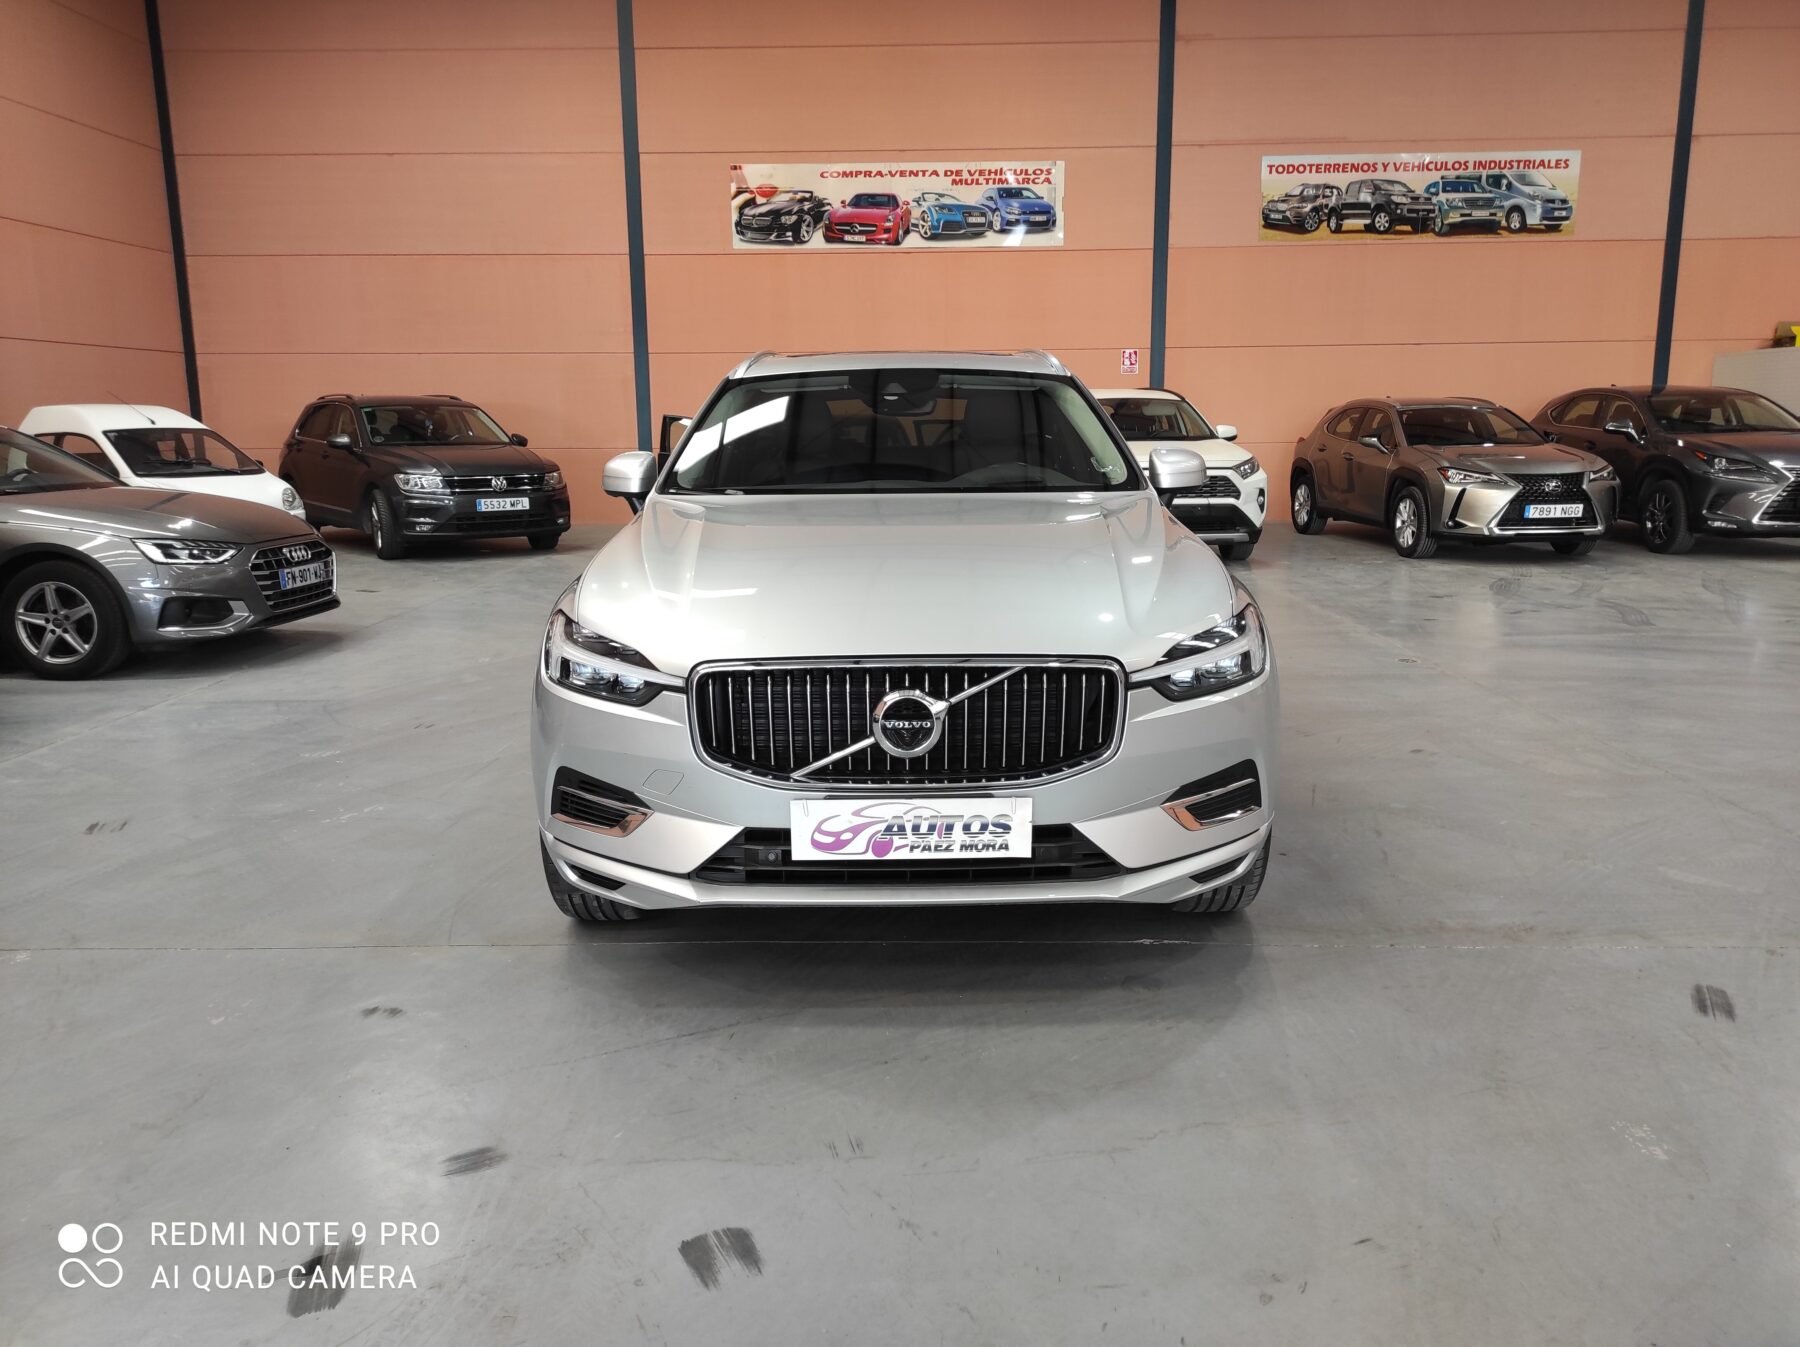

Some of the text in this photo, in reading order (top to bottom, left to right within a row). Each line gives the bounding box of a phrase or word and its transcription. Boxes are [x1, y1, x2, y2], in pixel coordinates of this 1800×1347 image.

[1267, 158, 1570, 175] TODOTERRENOS Y VEHÍCULOS INDUSTRIALES
[819, 169, 940, 179] COMPRA-VENTA
[943, 169, 964, 178] DE
[483, 499, 527, 510] 5532 MPL
[1531, 506, 1581, 517] 7891 NGG
[878, 814, 1014, 840] AUTOS
[959, 838, 1010, 853] MORA
